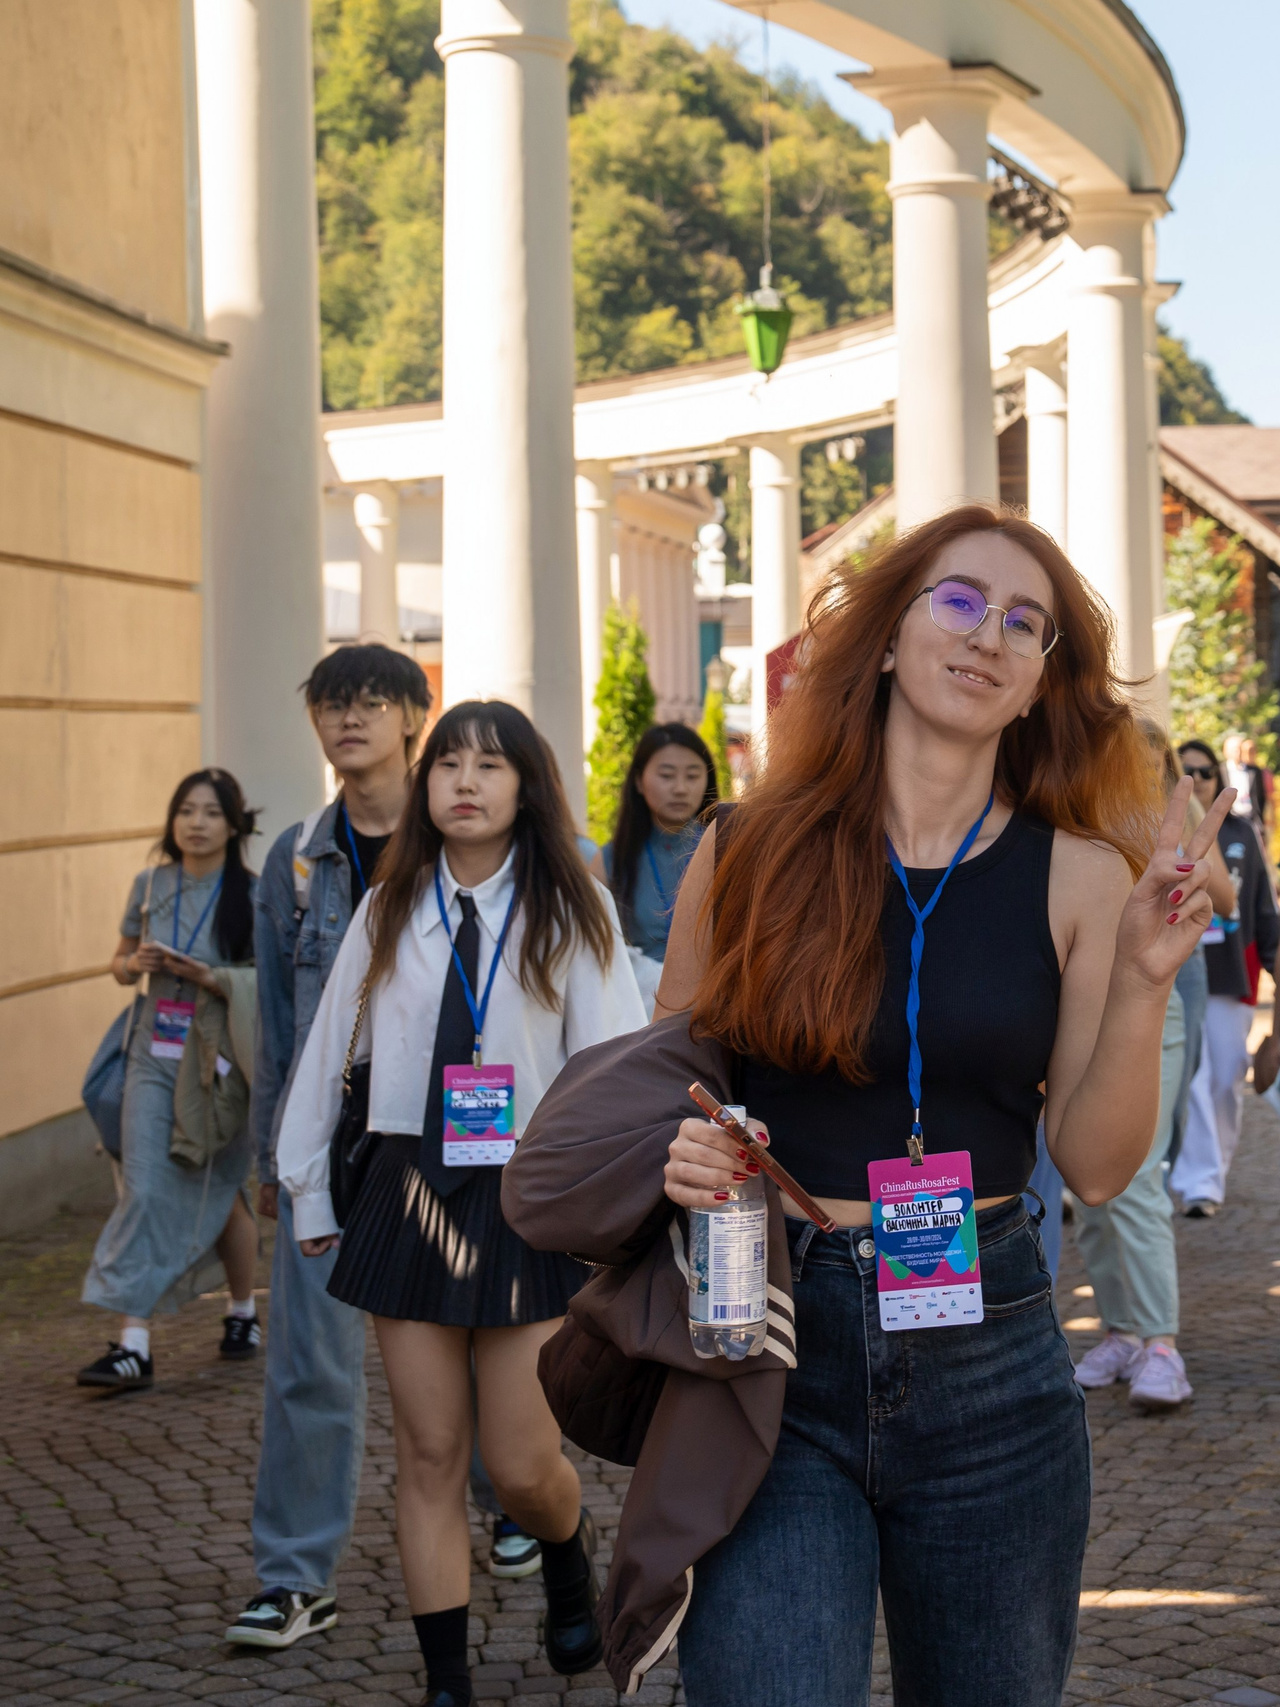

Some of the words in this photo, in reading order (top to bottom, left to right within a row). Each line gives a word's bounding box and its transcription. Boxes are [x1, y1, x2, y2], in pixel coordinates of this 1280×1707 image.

[880, 1176, 960, 1193] ChinaRusRosaFest
[894, 1200, 943, 1216] ВОЛОНТЕР
[886, 1217, 928, 1232] ВАСЮНИНА
[932, 1213, 961, 1228] МАРИЯ
